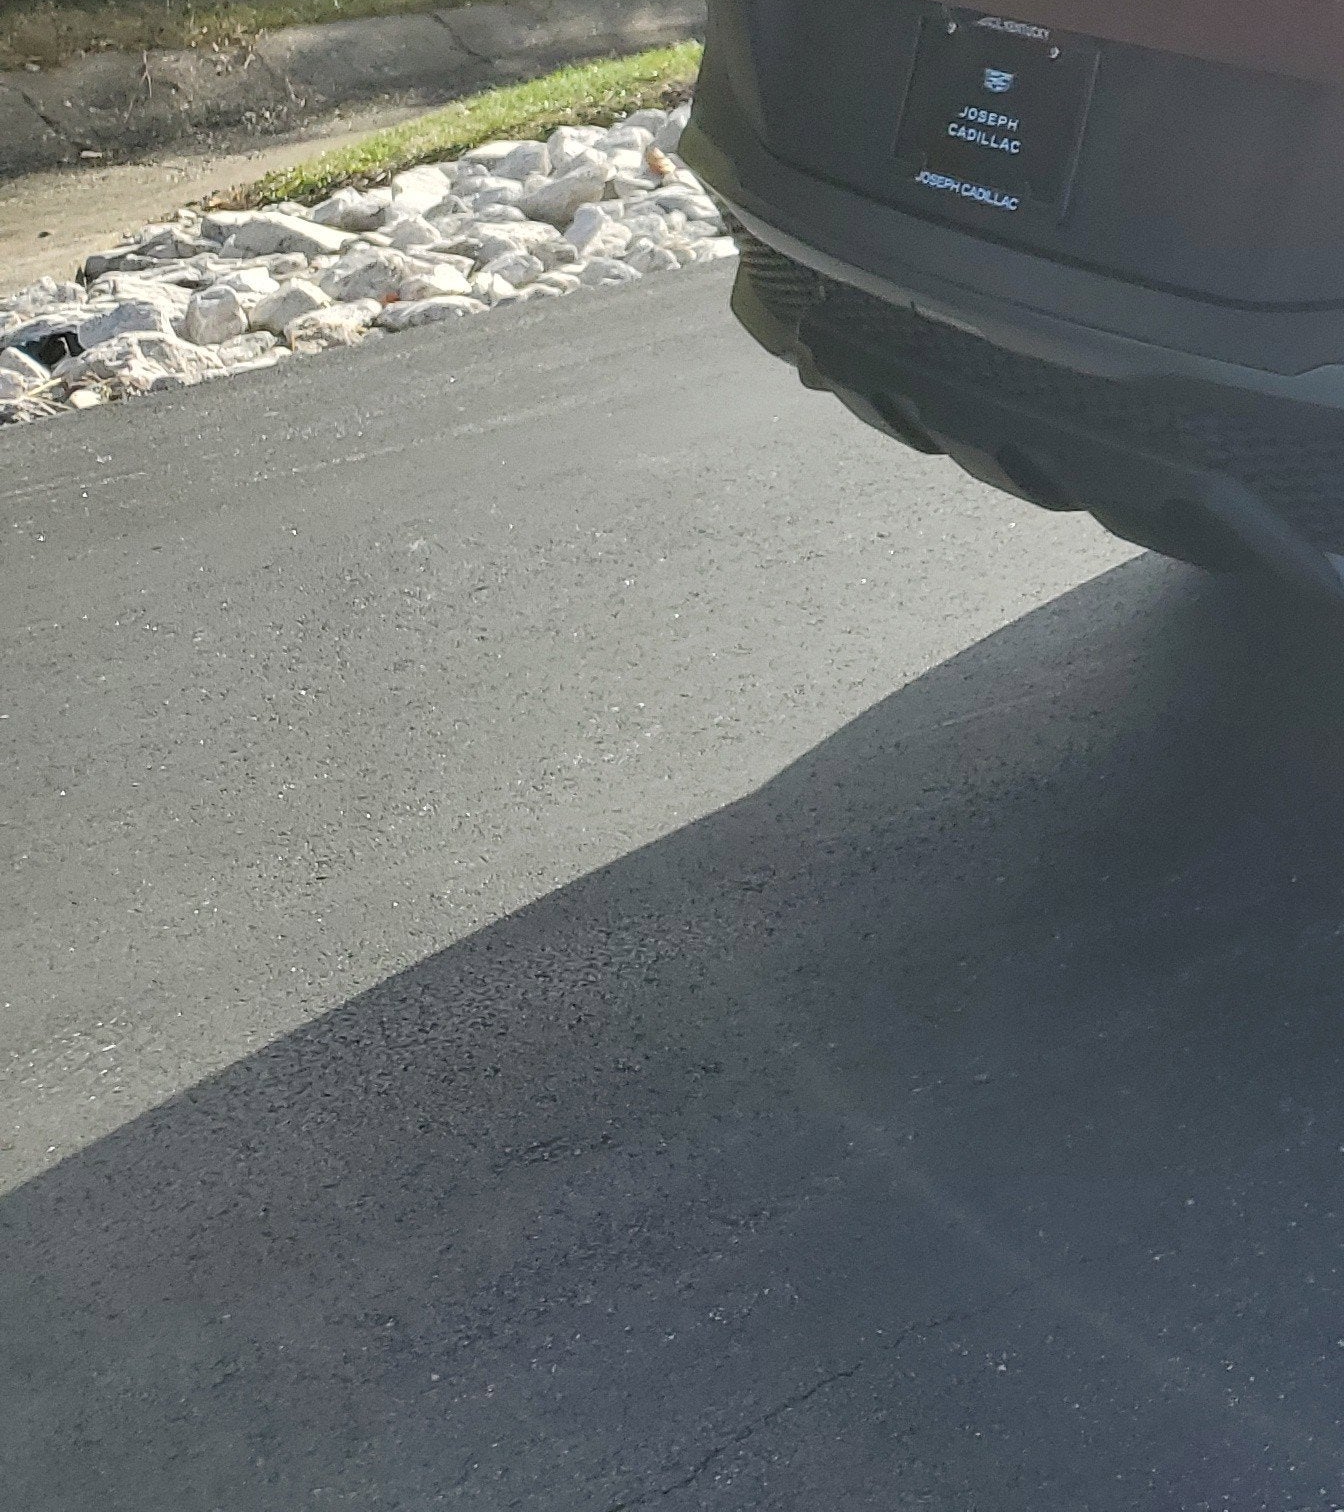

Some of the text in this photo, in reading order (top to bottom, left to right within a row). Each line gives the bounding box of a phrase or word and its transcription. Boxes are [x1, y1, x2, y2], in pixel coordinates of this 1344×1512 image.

[959, 106, 1018, 131] JOSEPH
[948, 123, 1021, 154] CADILLAC
[915, 171, 1019, 210] JOSEPH CADILLAC
